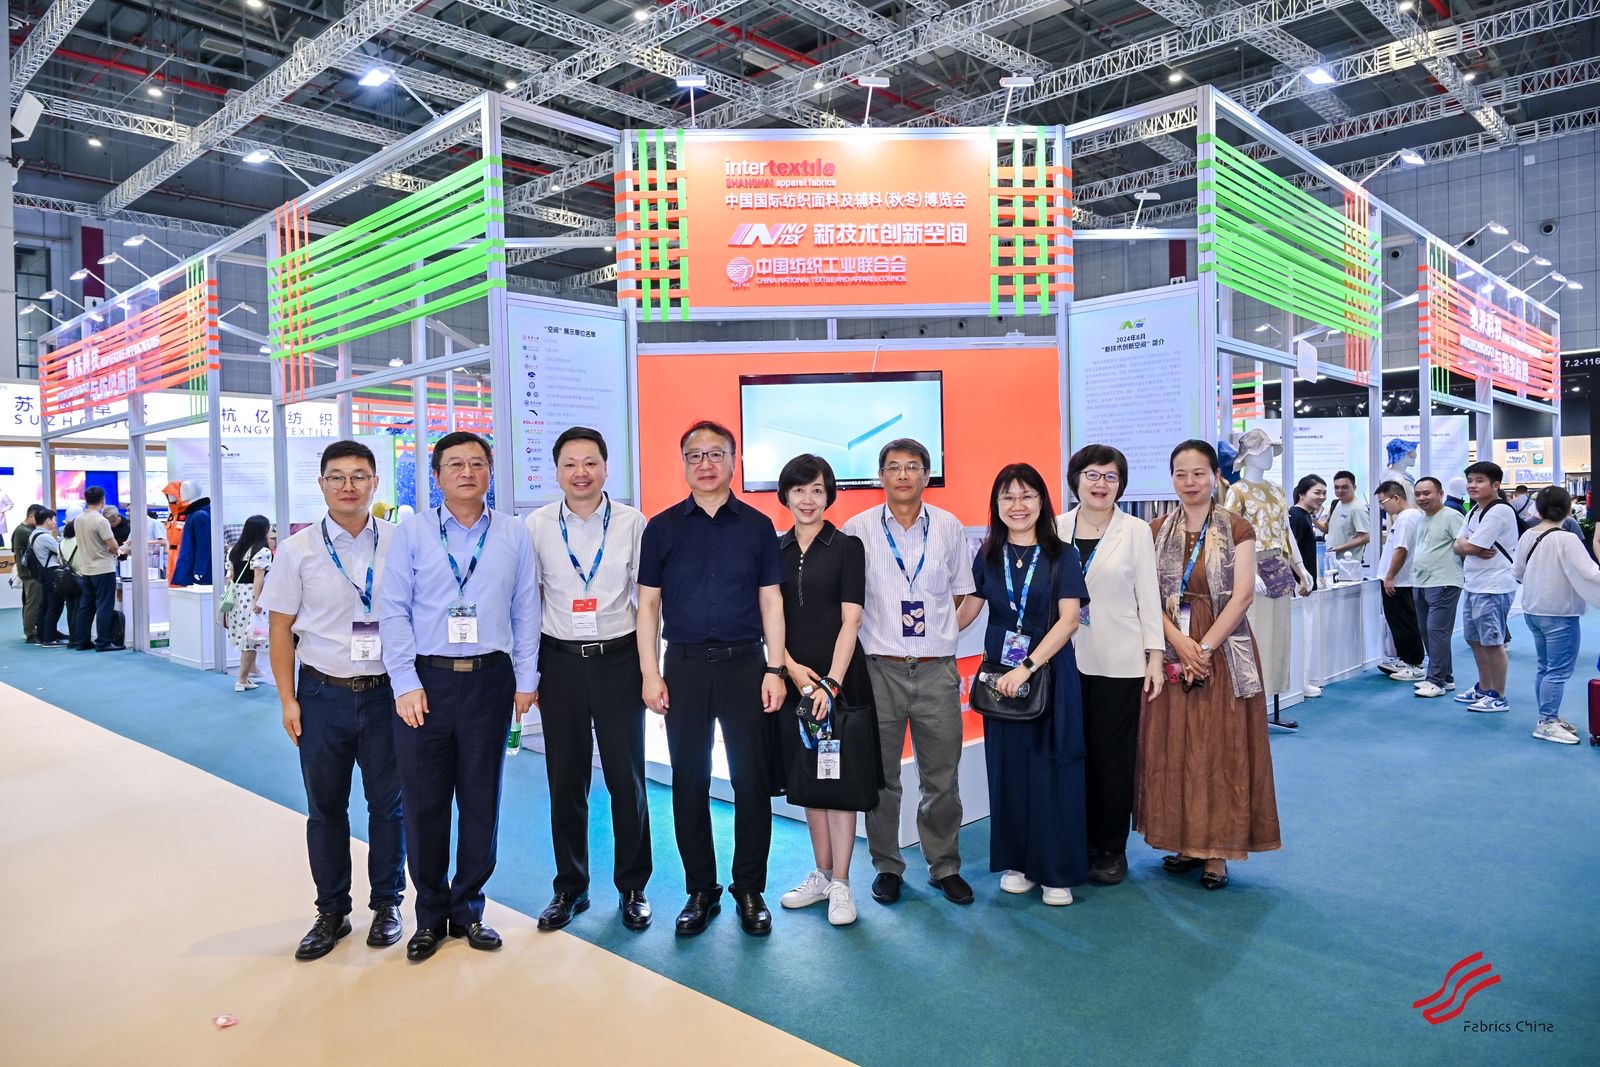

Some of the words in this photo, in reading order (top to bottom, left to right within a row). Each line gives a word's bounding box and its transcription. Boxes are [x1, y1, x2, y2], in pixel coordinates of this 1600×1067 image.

[726, 179, 773, 188] SHANGHAI
[775, 178, 806, 188] apparel
[808, 178, 837, 188] fabrics
[813, 223, 968, 245] 新技术创新空间
[756, 256, 907, 275] 中国纺织工业联合会
[878, 275, 906, 283] COUNCIL
[1564, 357, 1600, 368] 7.2-116
